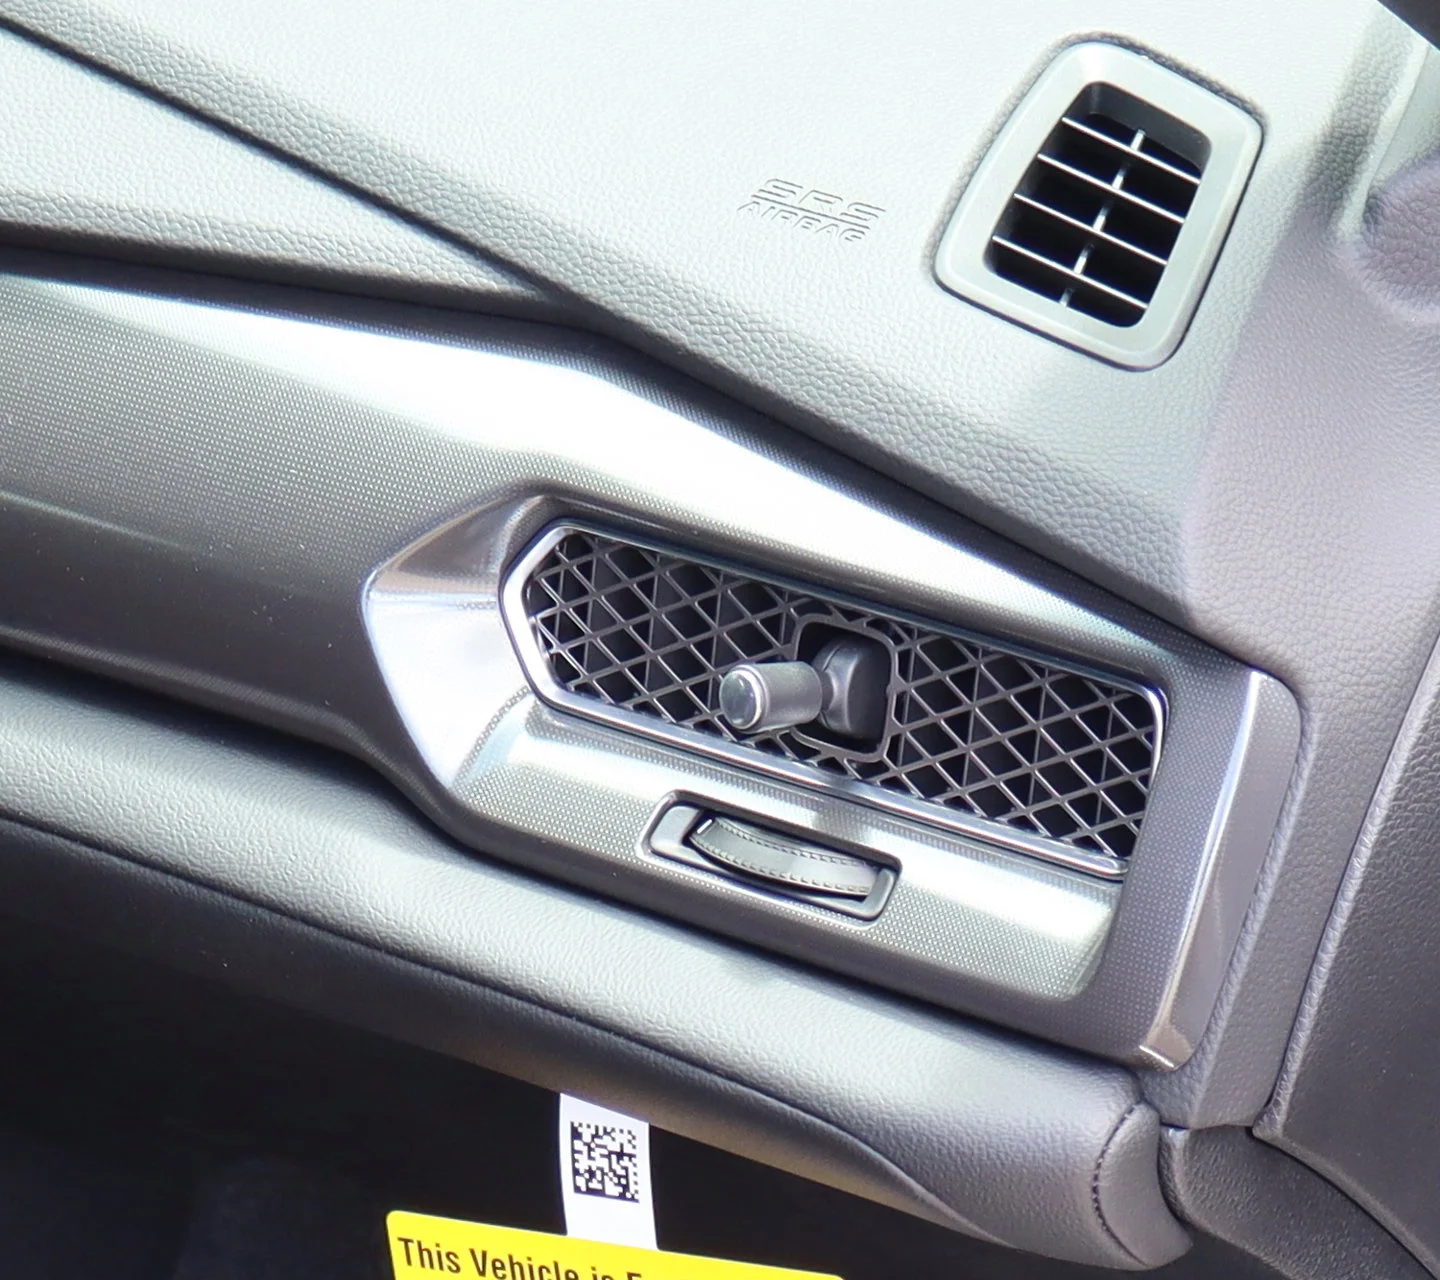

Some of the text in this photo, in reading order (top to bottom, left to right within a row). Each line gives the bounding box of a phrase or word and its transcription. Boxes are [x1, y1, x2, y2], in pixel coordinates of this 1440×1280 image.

[758, 178, 886, 221] SRS
[737, 201, 867, 243] AIRBAG
[397, 1237, 461, 1274] This
